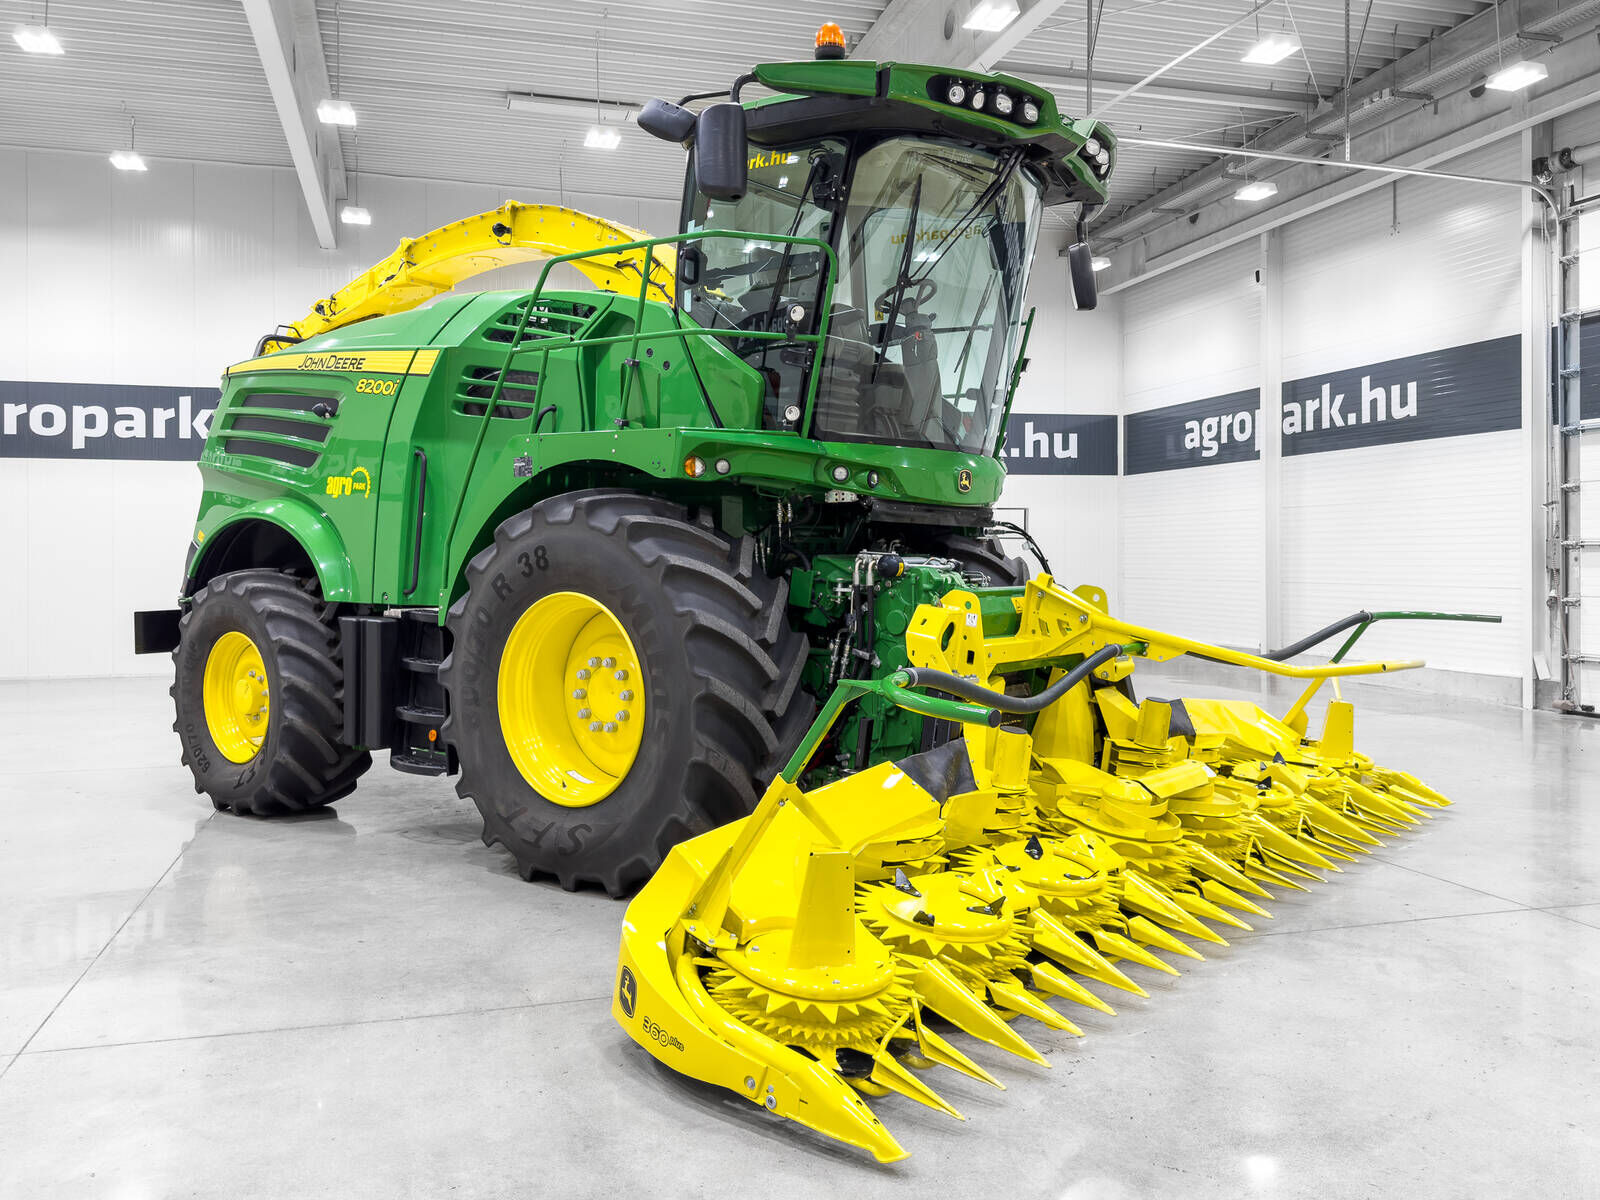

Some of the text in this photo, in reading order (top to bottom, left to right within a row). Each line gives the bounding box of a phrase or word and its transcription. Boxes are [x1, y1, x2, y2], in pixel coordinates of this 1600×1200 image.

[748, 151, 792, 170] rk.hu
[355, 378, 400, 396] 8200i
[326, 476, 353, 499] agro
[491, 572, 514, 601] R
[517, 544, 549, 577] 38
[496, 806, 593, 856] SFT
[643, 1016, 684, 1052] 360 plus
